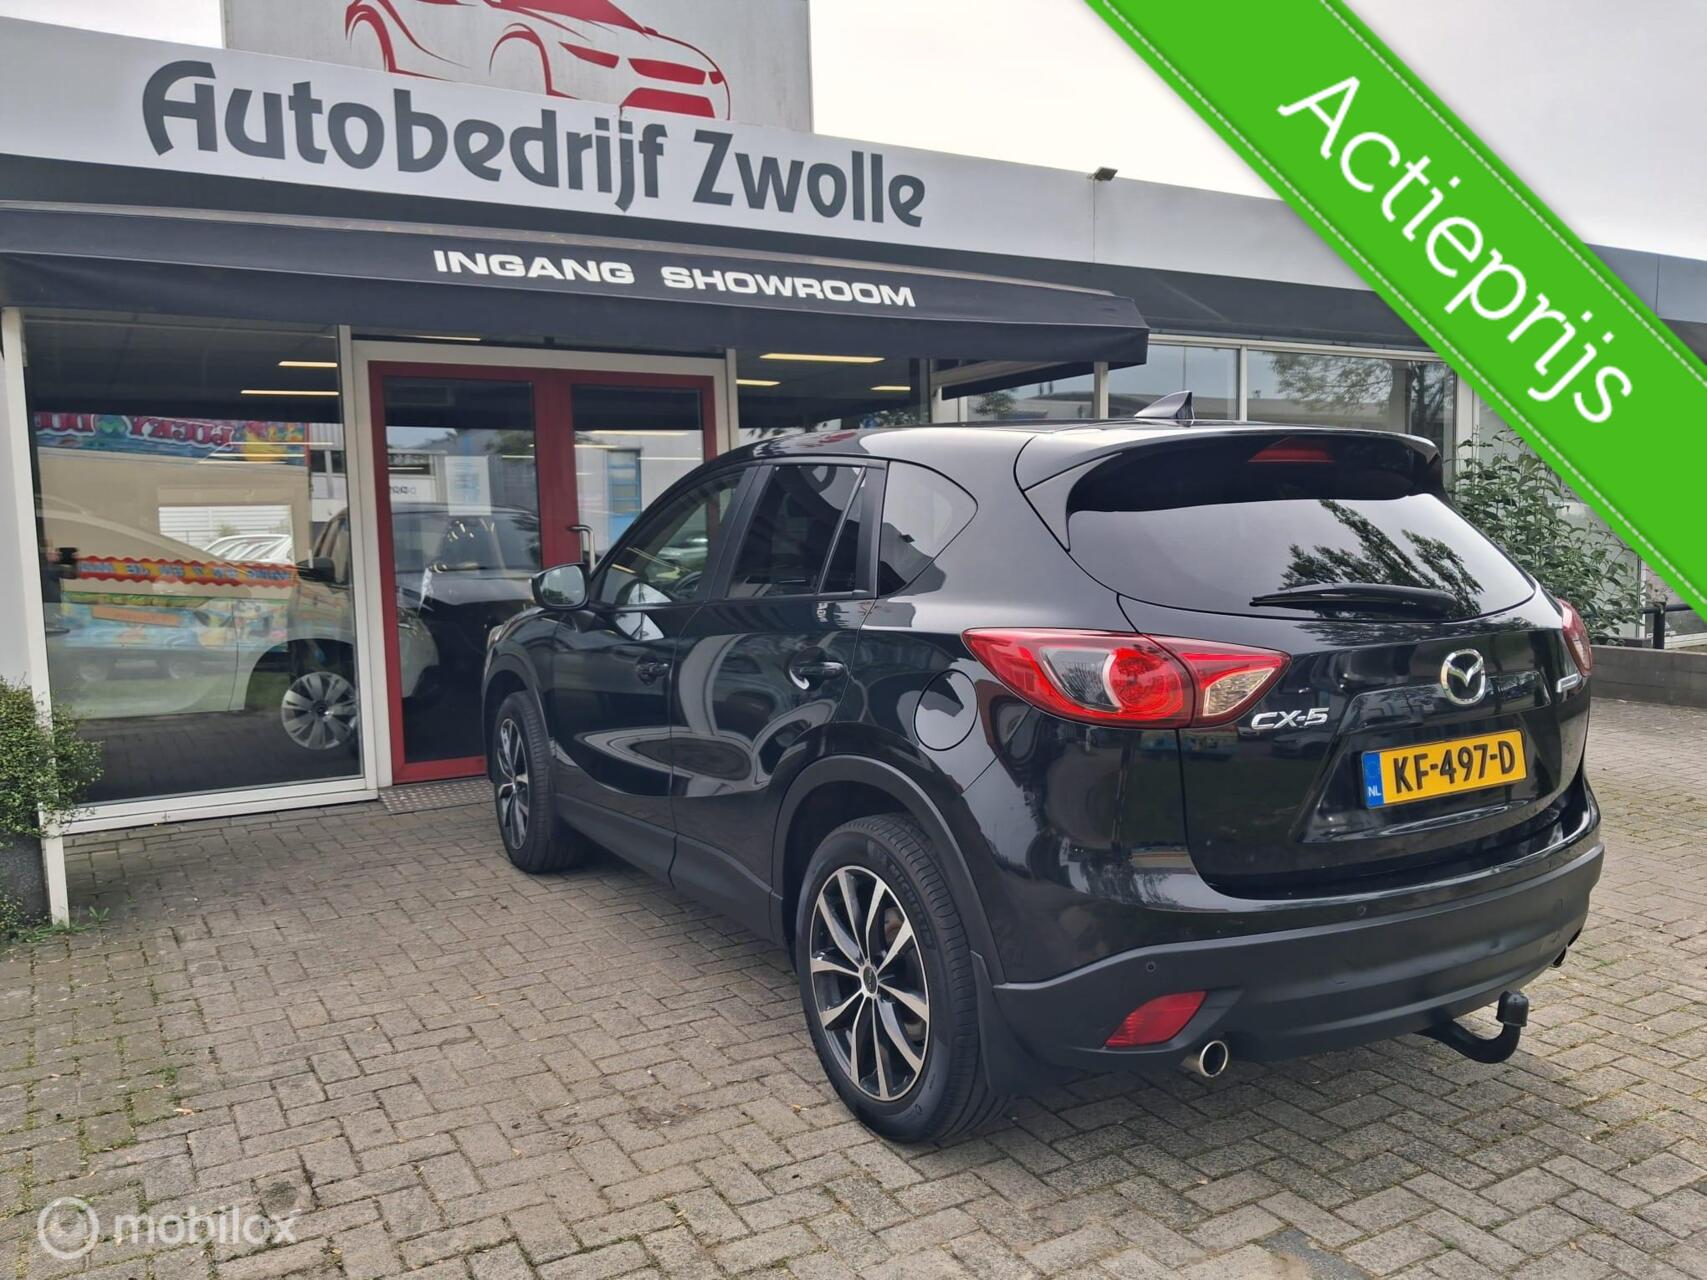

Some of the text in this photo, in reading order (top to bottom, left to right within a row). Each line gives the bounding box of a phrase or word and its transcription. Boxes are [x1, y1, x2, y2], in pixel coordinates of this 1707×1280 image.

[142, 60, 925, 228] Autobedrijf Zwolle
[433, 250, 916, 308] INGANG SHOWROOM
[1251, 707, 1330, 731] CX-5
[1367, 785, 1382, 797] NL
[1393, 740, 1516, 794] KF-497-D
